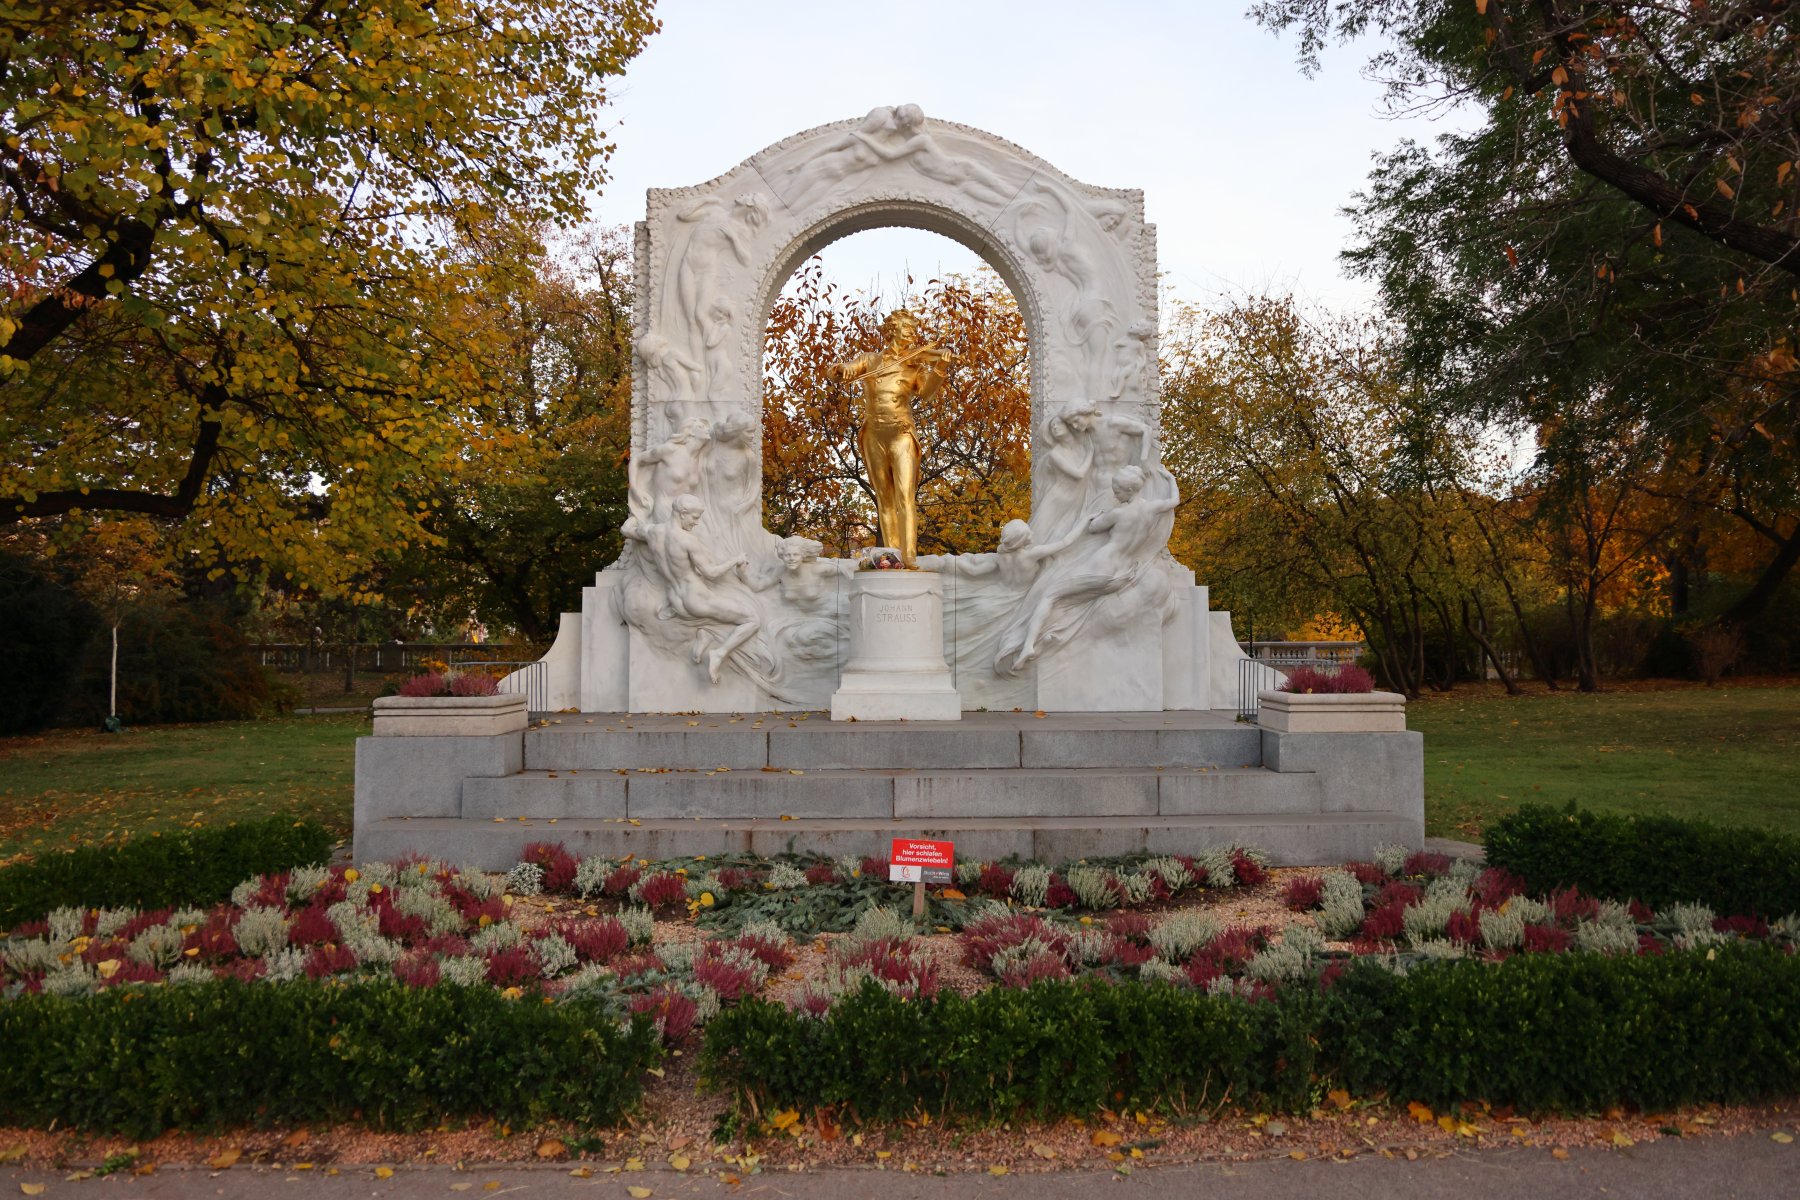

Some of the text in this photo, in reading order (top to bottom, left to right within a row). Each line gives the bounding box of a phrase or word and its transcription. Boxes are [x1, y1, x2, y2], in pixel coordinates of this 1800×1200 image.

[879, 604, 913, 612] JOHANN
[876, 613, 917, 623] STRAUSS
[909, 843, 936, 851] Vorsicht,
[895, 855, 949, 864] Blumenzwiebeln!
